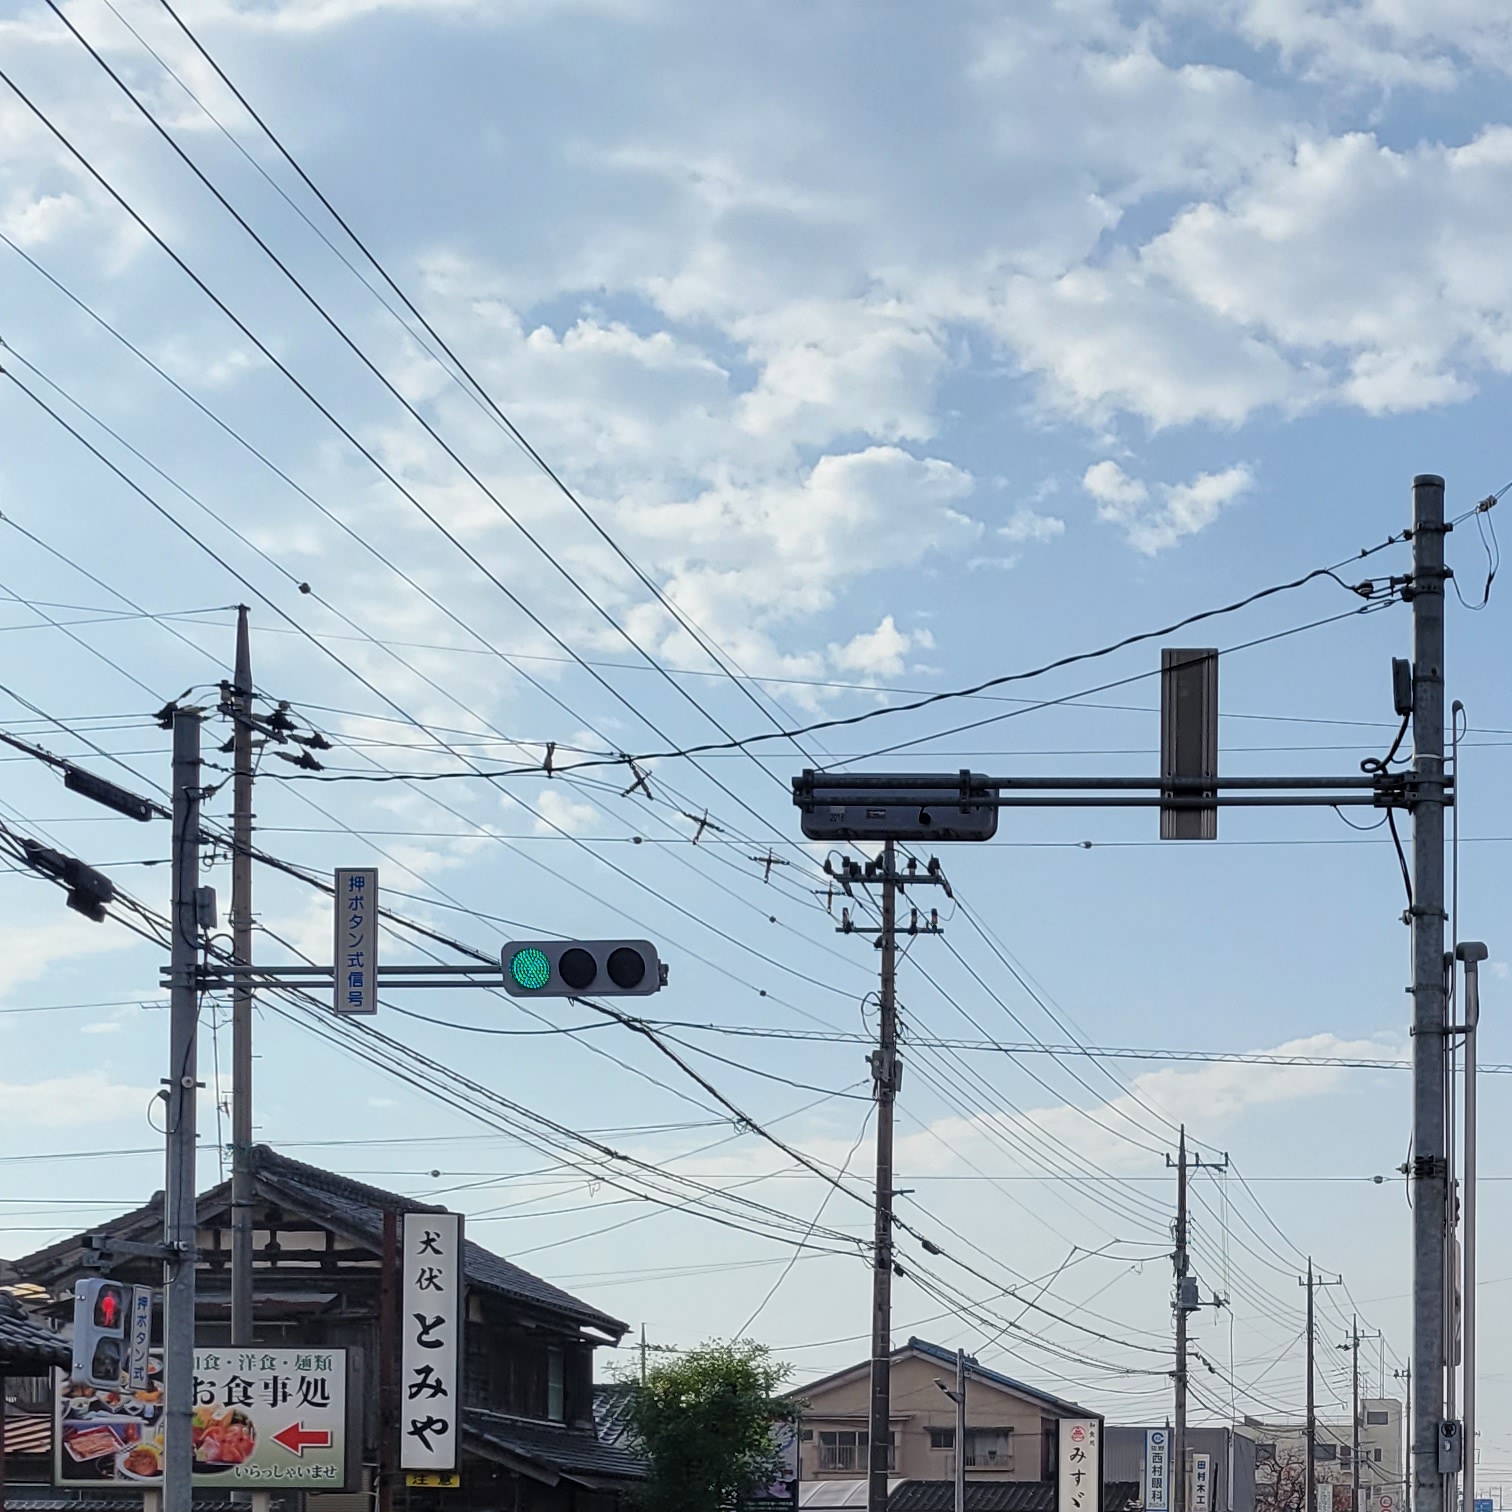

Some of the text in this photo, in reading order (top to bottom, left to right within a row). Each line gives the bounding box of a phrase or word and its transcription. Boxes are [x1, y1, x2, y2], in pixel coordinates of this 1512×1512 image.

[347, 876, 365, 1007] 押ボタン式信号
[133, 1296, 148, 1382] 押ボタン式
[193, 1374, 331, 1409] お食事処
[235, 1464, 338, 1480] いらっしゃいませ
[1151, 1452, 1163, 1502] 西村眼科
